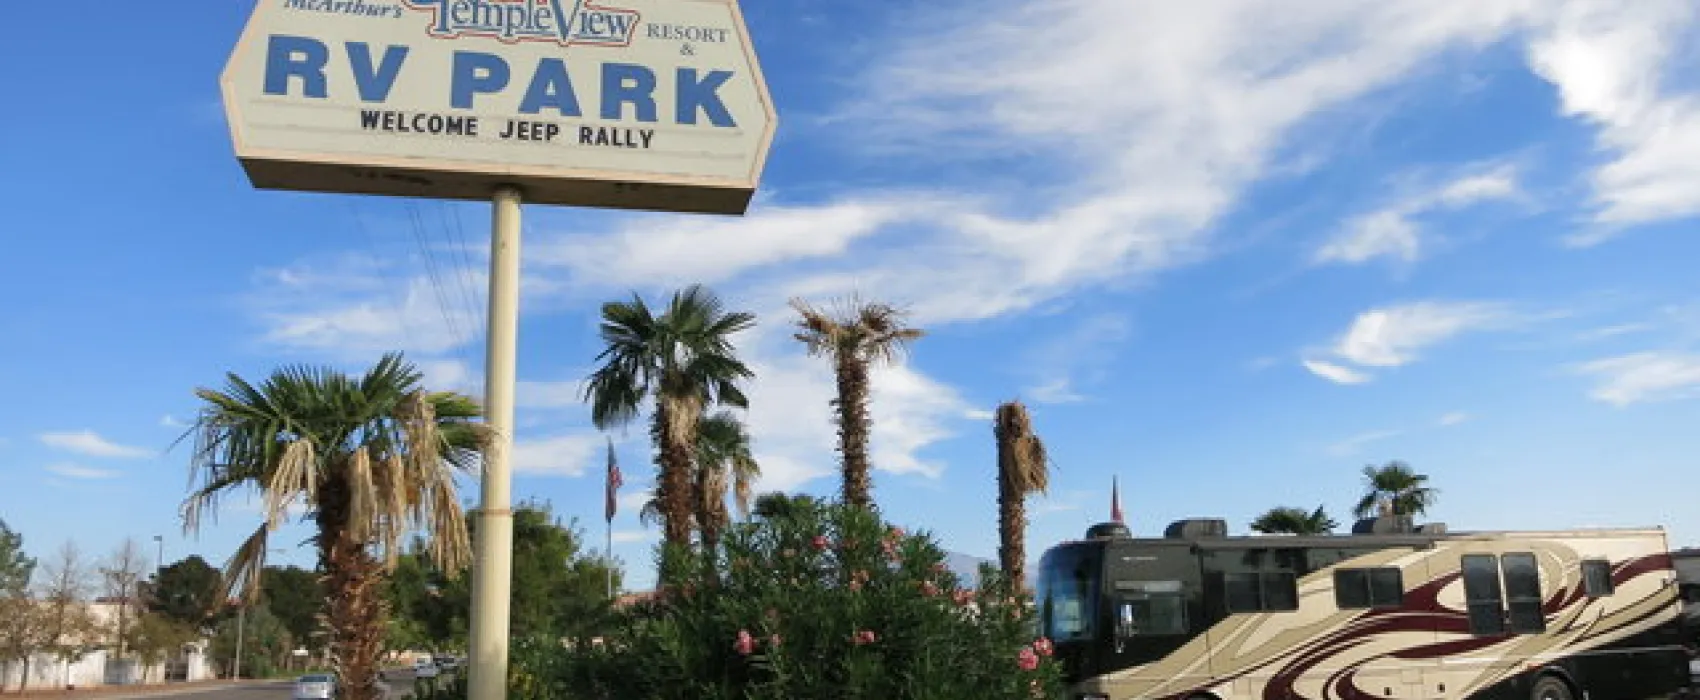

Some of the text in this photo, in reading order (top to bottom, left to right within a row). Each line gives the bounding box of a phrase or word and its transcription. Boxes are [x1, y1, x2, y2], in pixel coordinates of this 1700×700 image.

[646, 23, 729, 43] RESORT
[679, 43, 696, 56] &
[262, 34, 738, 127] RV PARK
[360, 109, 655, 149] WELCOME JEEP RALLY
